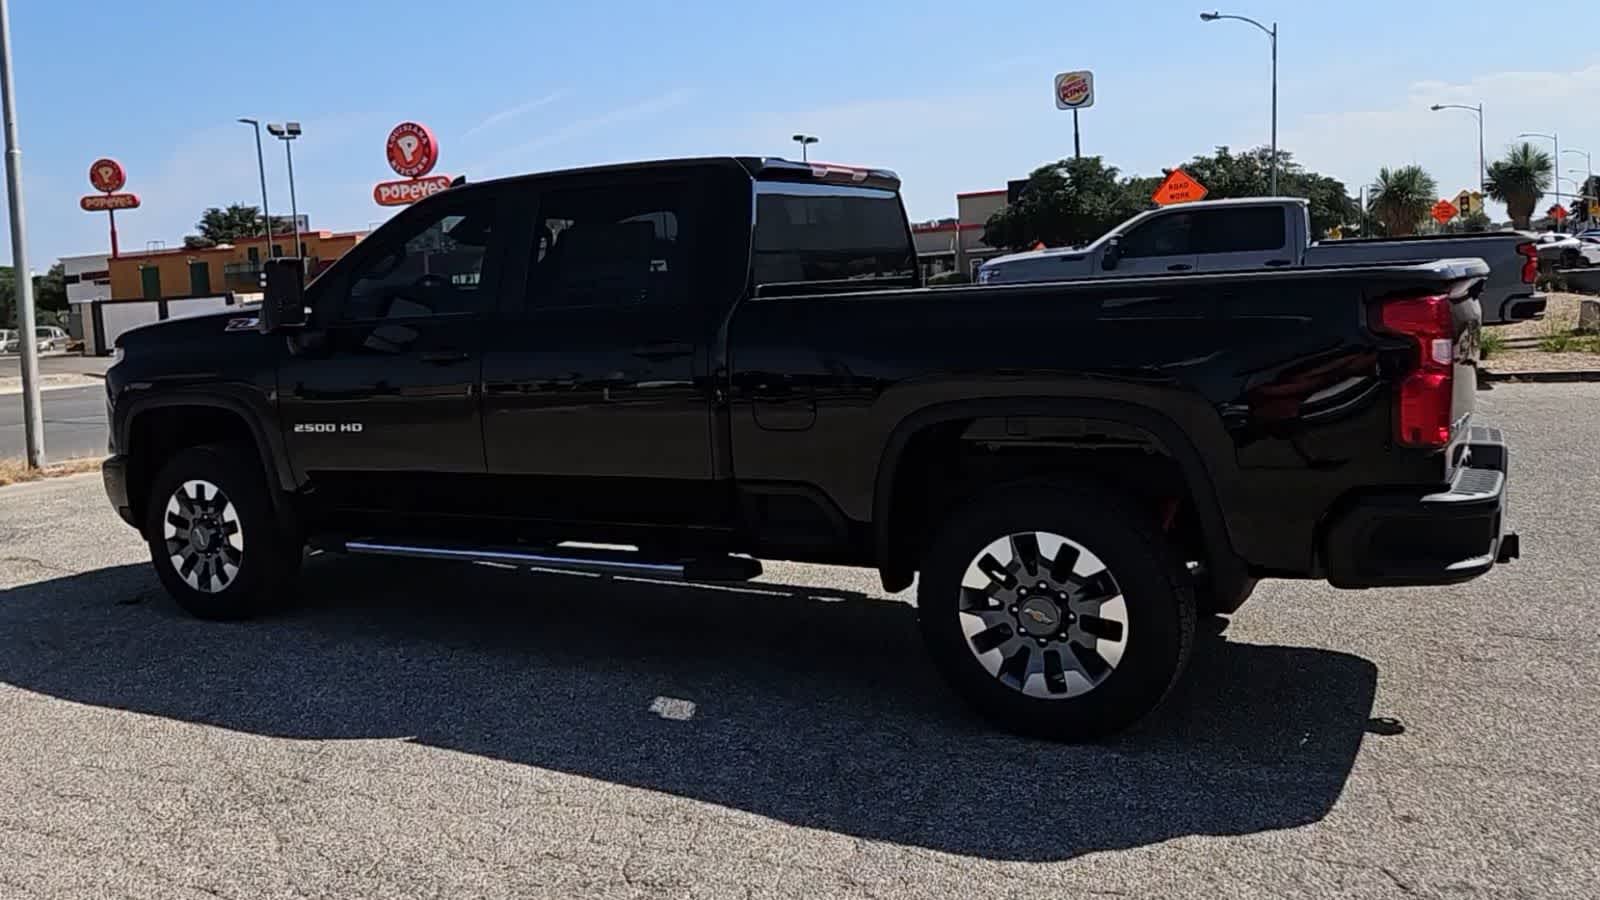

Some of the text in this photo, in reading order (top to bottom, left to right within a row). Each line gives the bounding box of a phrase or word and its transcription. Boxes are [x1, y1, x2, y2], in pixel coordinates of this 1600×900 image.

[1168, 182, 1189, 191] ROAD
[1169, 191, 1190, 200] WORK
[294, 422, 363, 433] 2500 HD
